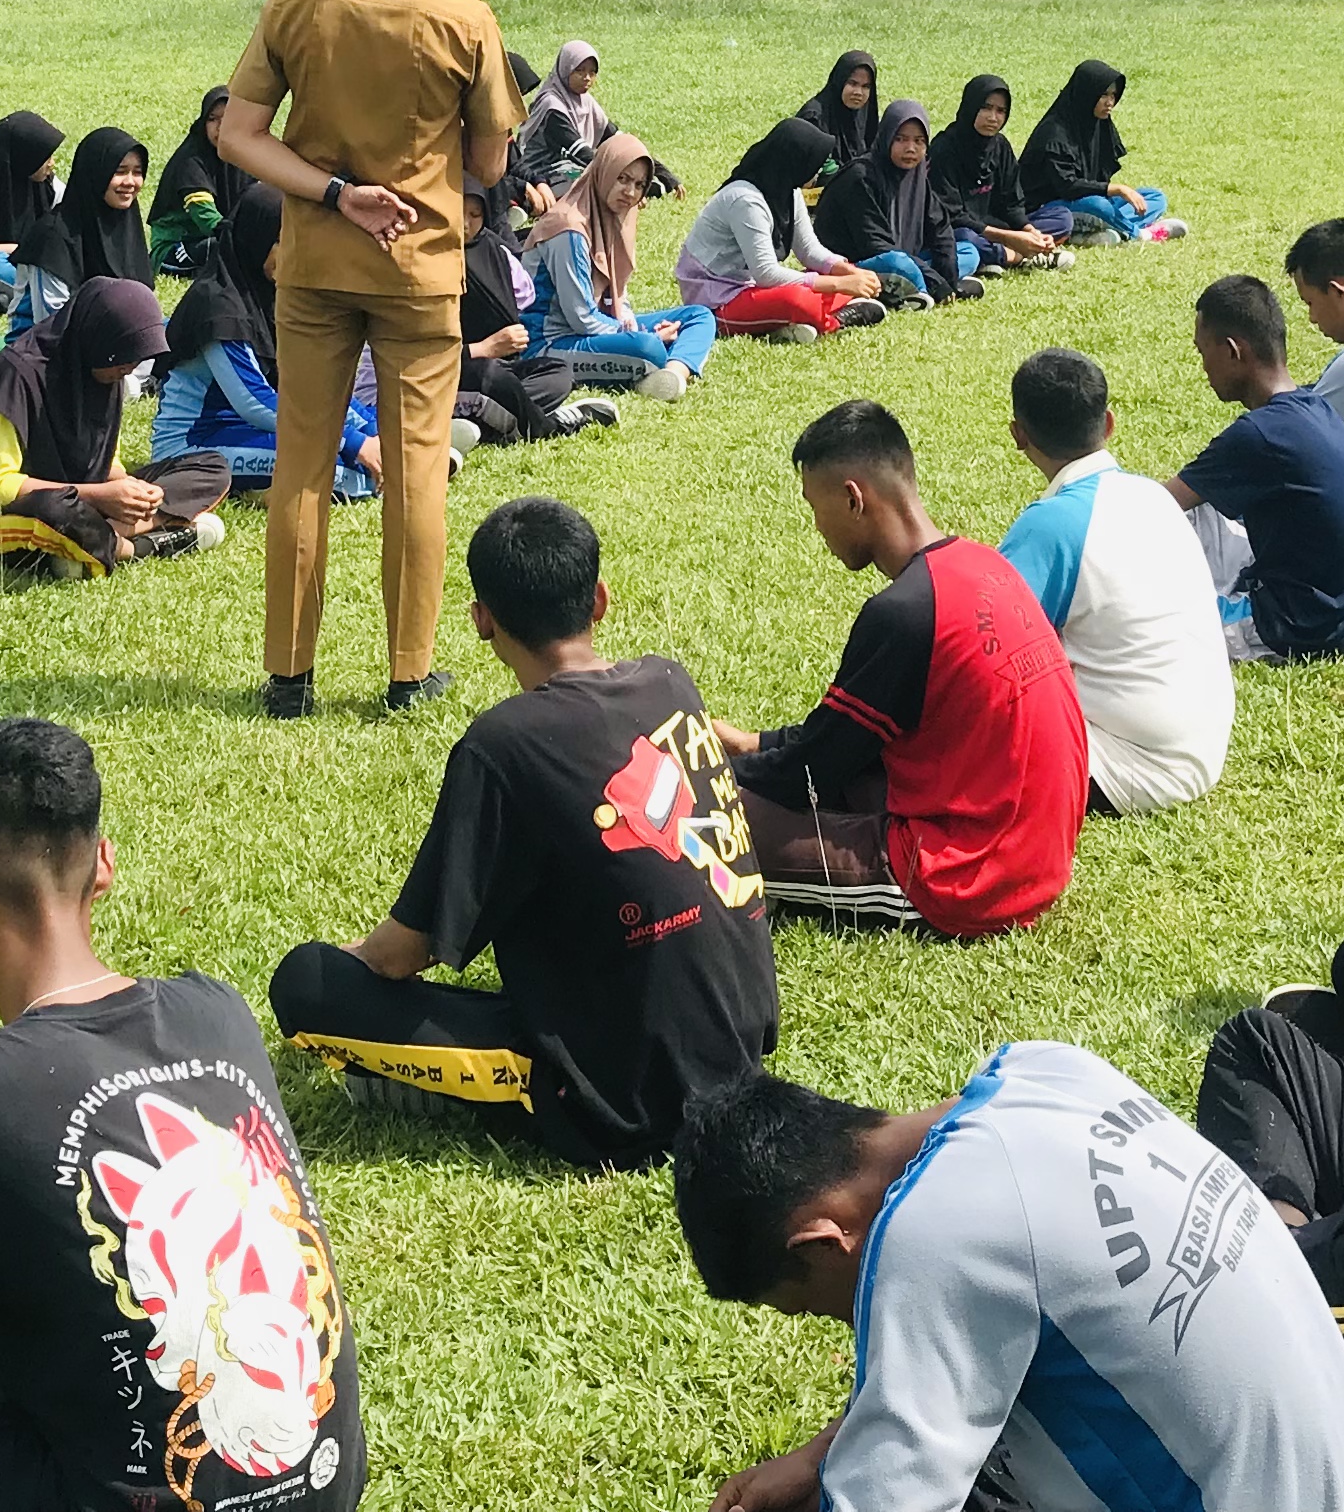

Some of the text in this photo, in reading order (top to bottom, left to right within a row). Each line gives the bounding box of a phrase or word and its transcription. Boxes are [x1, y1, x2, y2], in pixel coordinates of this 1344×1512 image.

[625, 905, 702, 941] JACKARMY
[379, 1058, 443, 1083] BASA
[1146, 1151, 1188, 1183] 1
[1087, 1147, 1151, 1289] UPT
[1181, 1160, 1241, 1269] BASA AMPEK
[1222, 1228, 1246, 1273] BALAI
[101, 1329, 131, 1343] TRADE
[110, 1345, 153, 1459] キツネ
[126, 1464, 148, 1475] MARK
